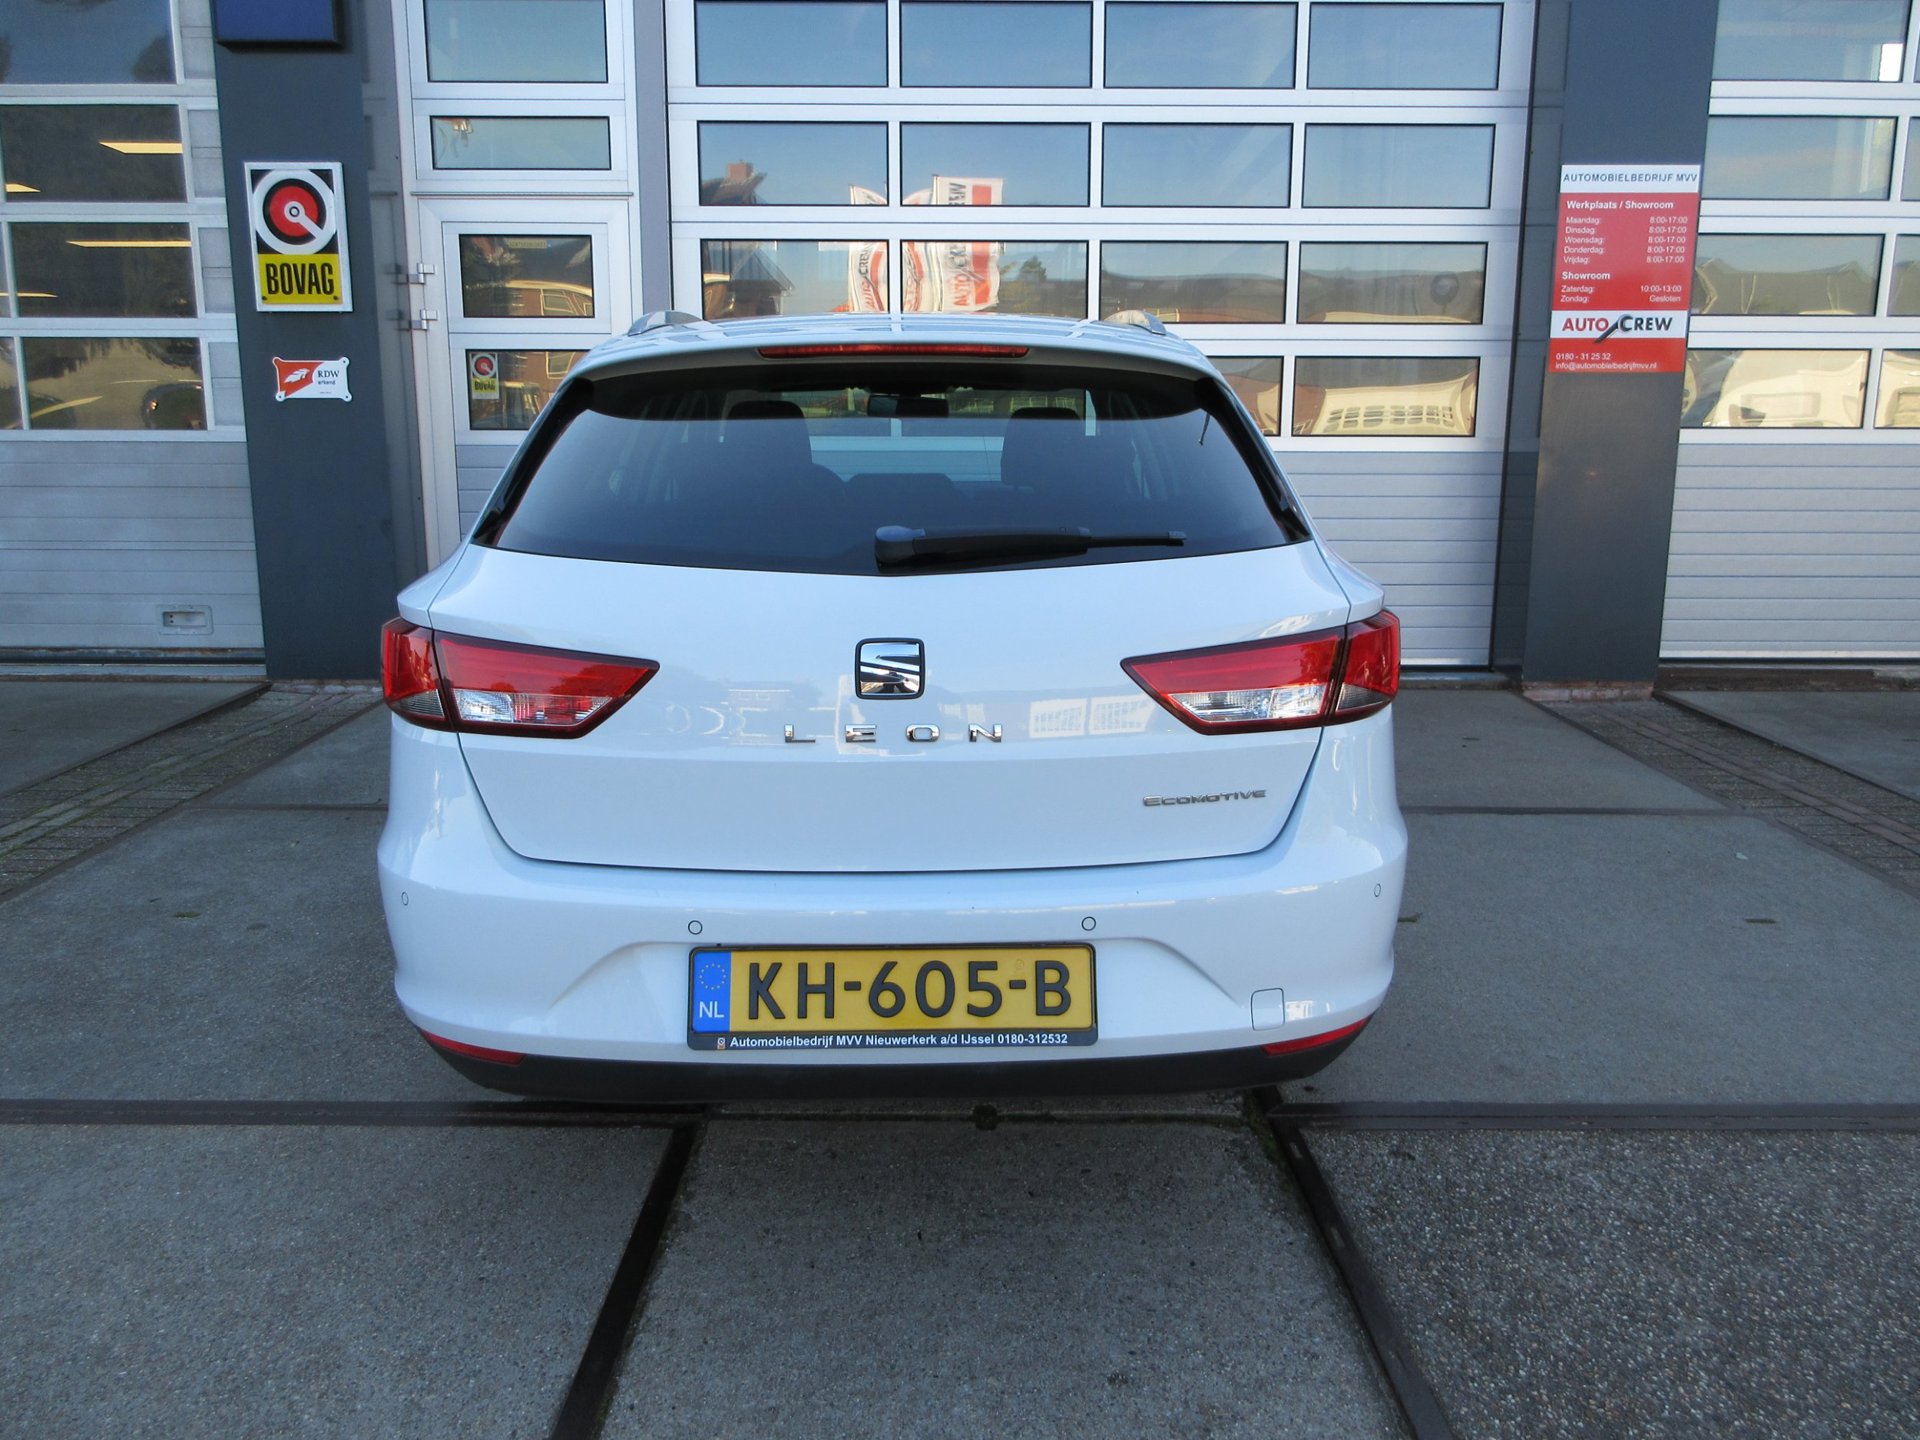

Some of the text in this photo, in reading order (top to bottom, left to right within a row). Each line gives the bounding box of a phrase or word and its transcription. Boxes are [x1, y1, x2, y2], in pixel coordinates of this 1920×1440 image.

[1563, 173, 1698, 183] AUTOMOBIELBEDRIJF MVV
[1566, 200, 1674, 210] Werkplaats / Showroom
[1566, 216, 1688, 225] Maandag: 8:00-17:00
[1565, 226, 1687, 235] Dinsdag: 8:00-17:00
[1565, 236, 1686, 245] Woensdag: 8:00-17:00
[1563, 246, 1685, 255] Donderdag: 8:00-17:00
[1563, 255, 1685, 264] Vrijdag: 8:00-17:00
[265, 262, 335, 296] BOVAG
[1561, 271, 1611, 280] Showroom
[1561, 285, 1595, 293] Zaterdag:
[1560, 294, 1681, 303] Zondag: Gesloten
[1562, 314, 1673, 333] AUTO CREW
[1556, 352, 1574, 360] 0180
[1581, 352, 1589, 360] 31
[1591, 352, 1600, 360] 25
[1601, 352, 1612, 360] 32
[1555, 361, 1657, 371] info@automobielbedrijfmvv.nl
[317, 370, 340, 378] RDW
[784, 723, 1003, 744] LEON
[1143, 789, 1267, 807] ECOMOTIVE
[748, 960, 1072, 1019] KH-605-B
[699, 1001, 725, 1018] NL
[730, 1033, 1068, 1049] Automobielbedrijf MVV Nieuwerkerk a/d IJssel 0180-312532
